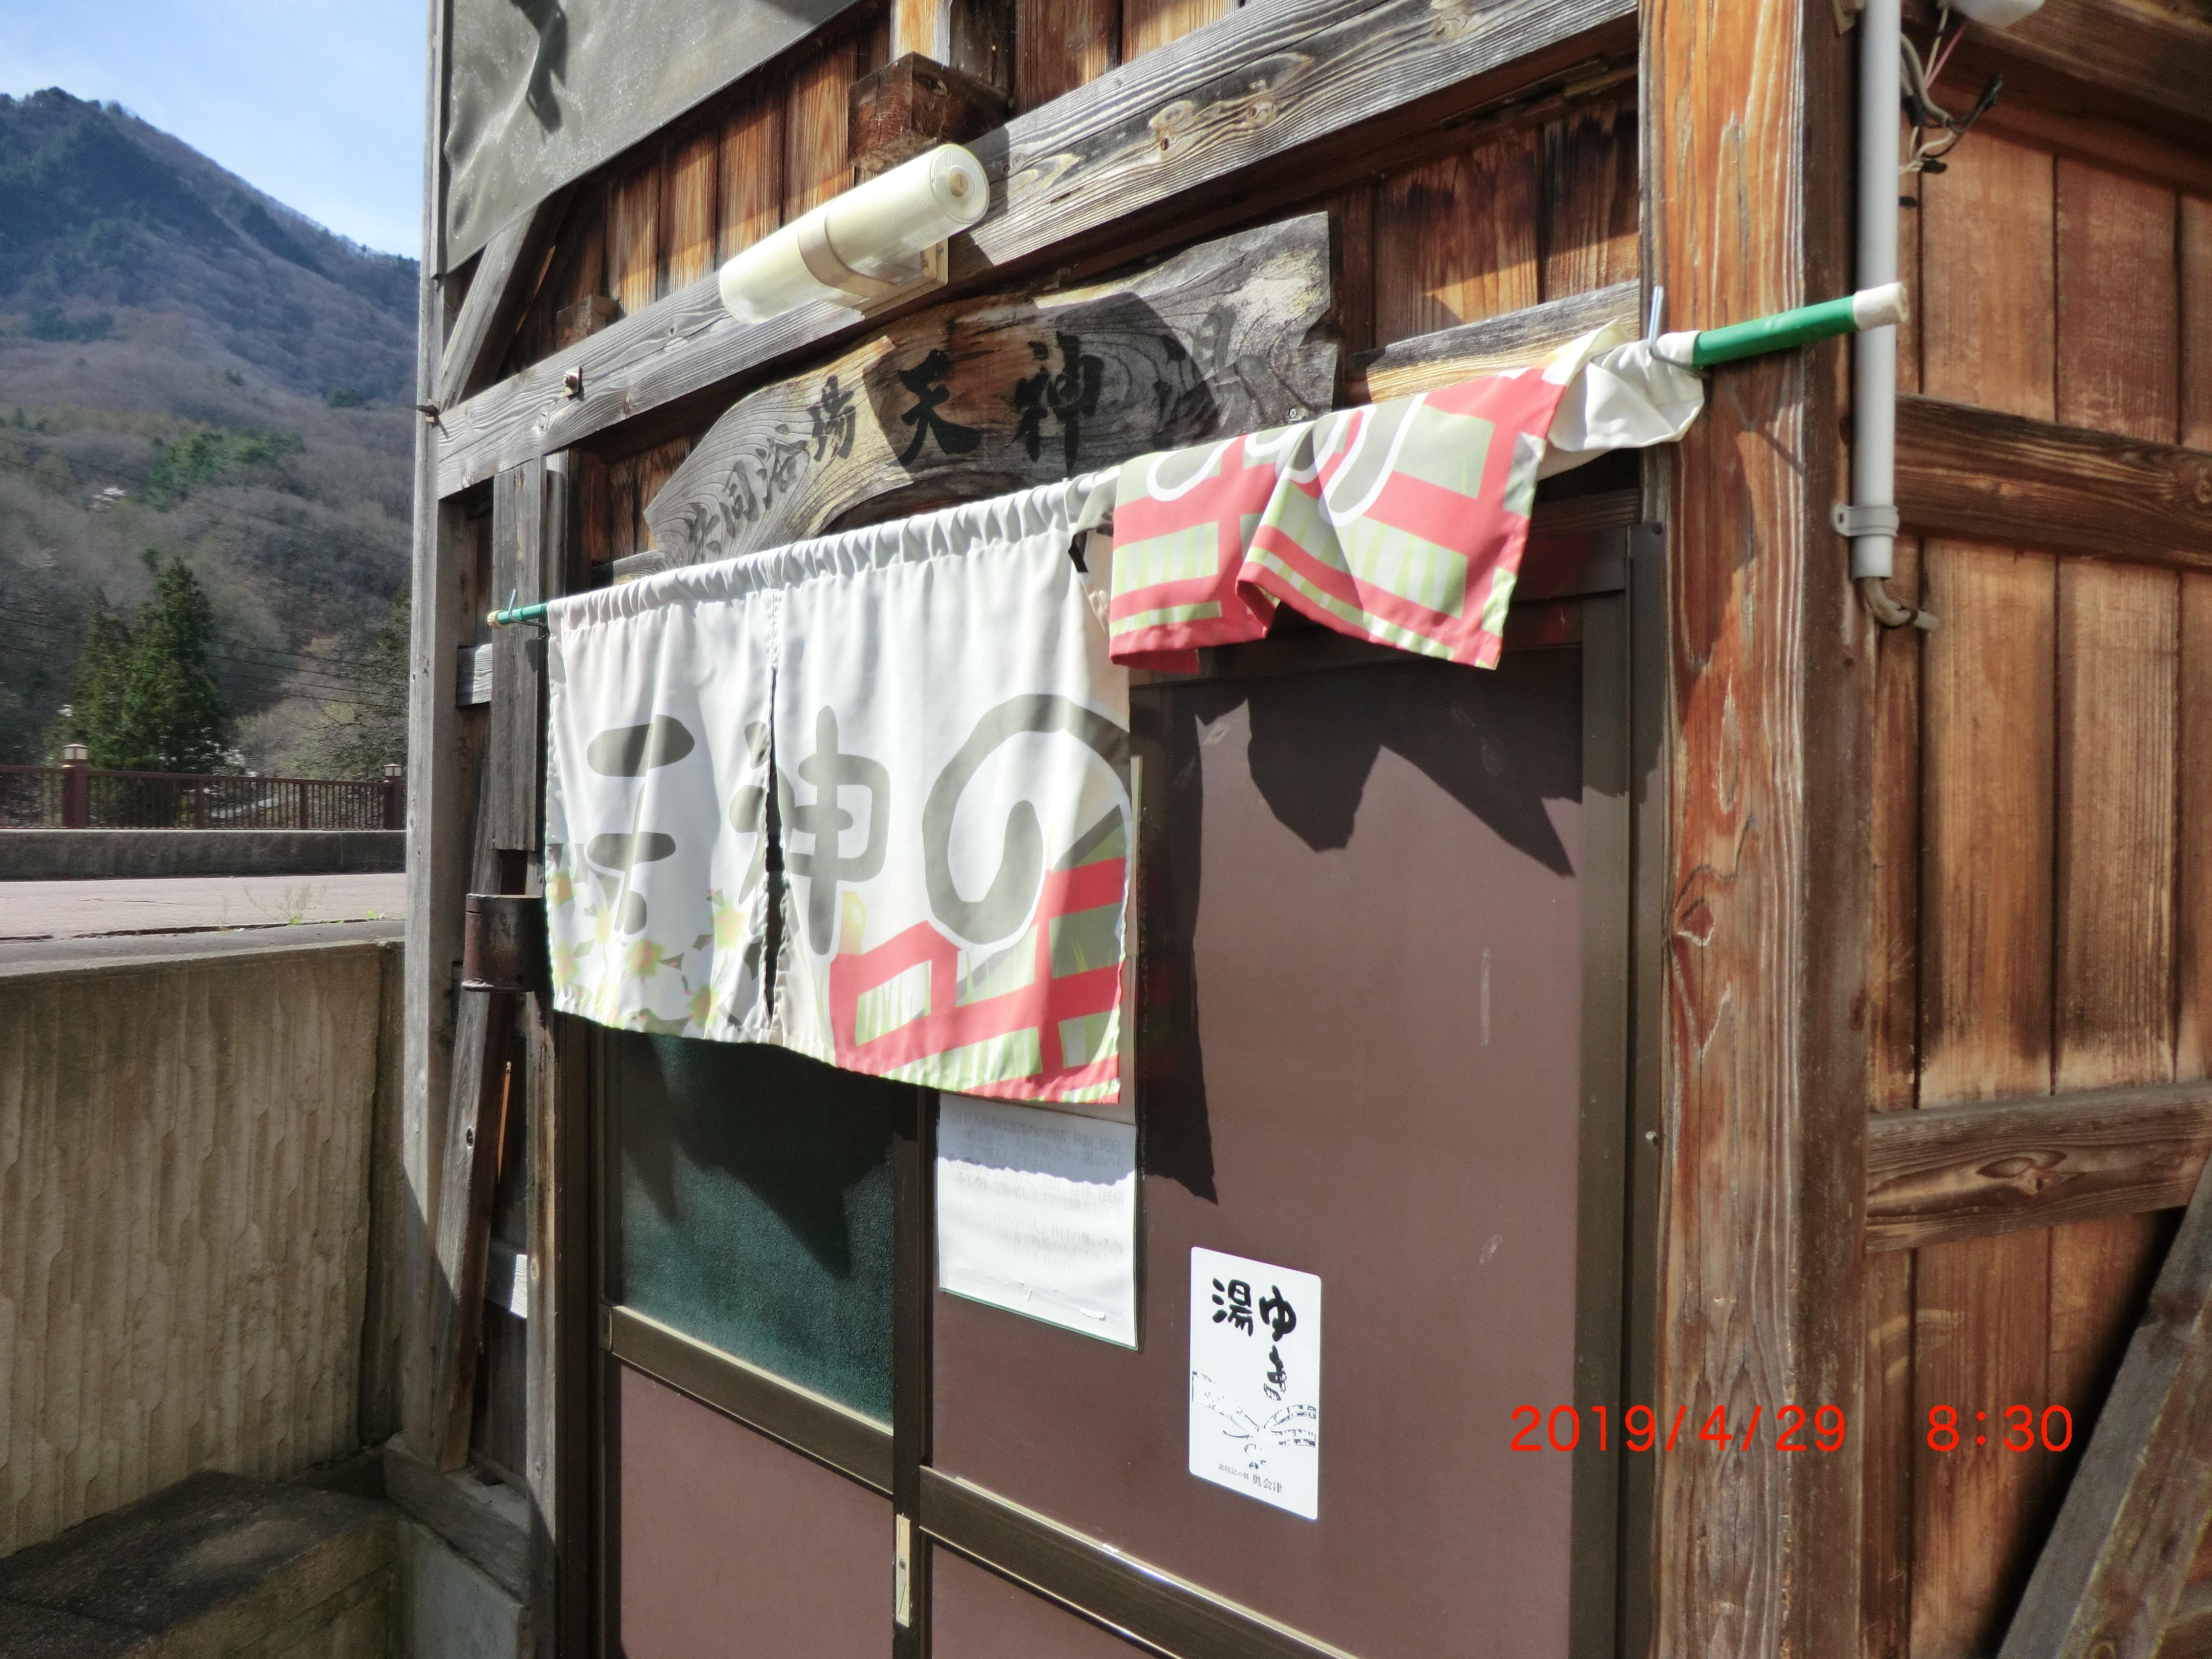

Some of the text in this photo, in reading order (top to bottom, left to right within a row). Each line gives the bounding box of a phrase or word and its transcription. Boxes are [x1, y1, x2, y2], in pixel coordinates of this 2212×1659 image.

[1212, 1278, 1253, 1337] 湯
[1252, 1473, 1284, 1493] 奥会津
